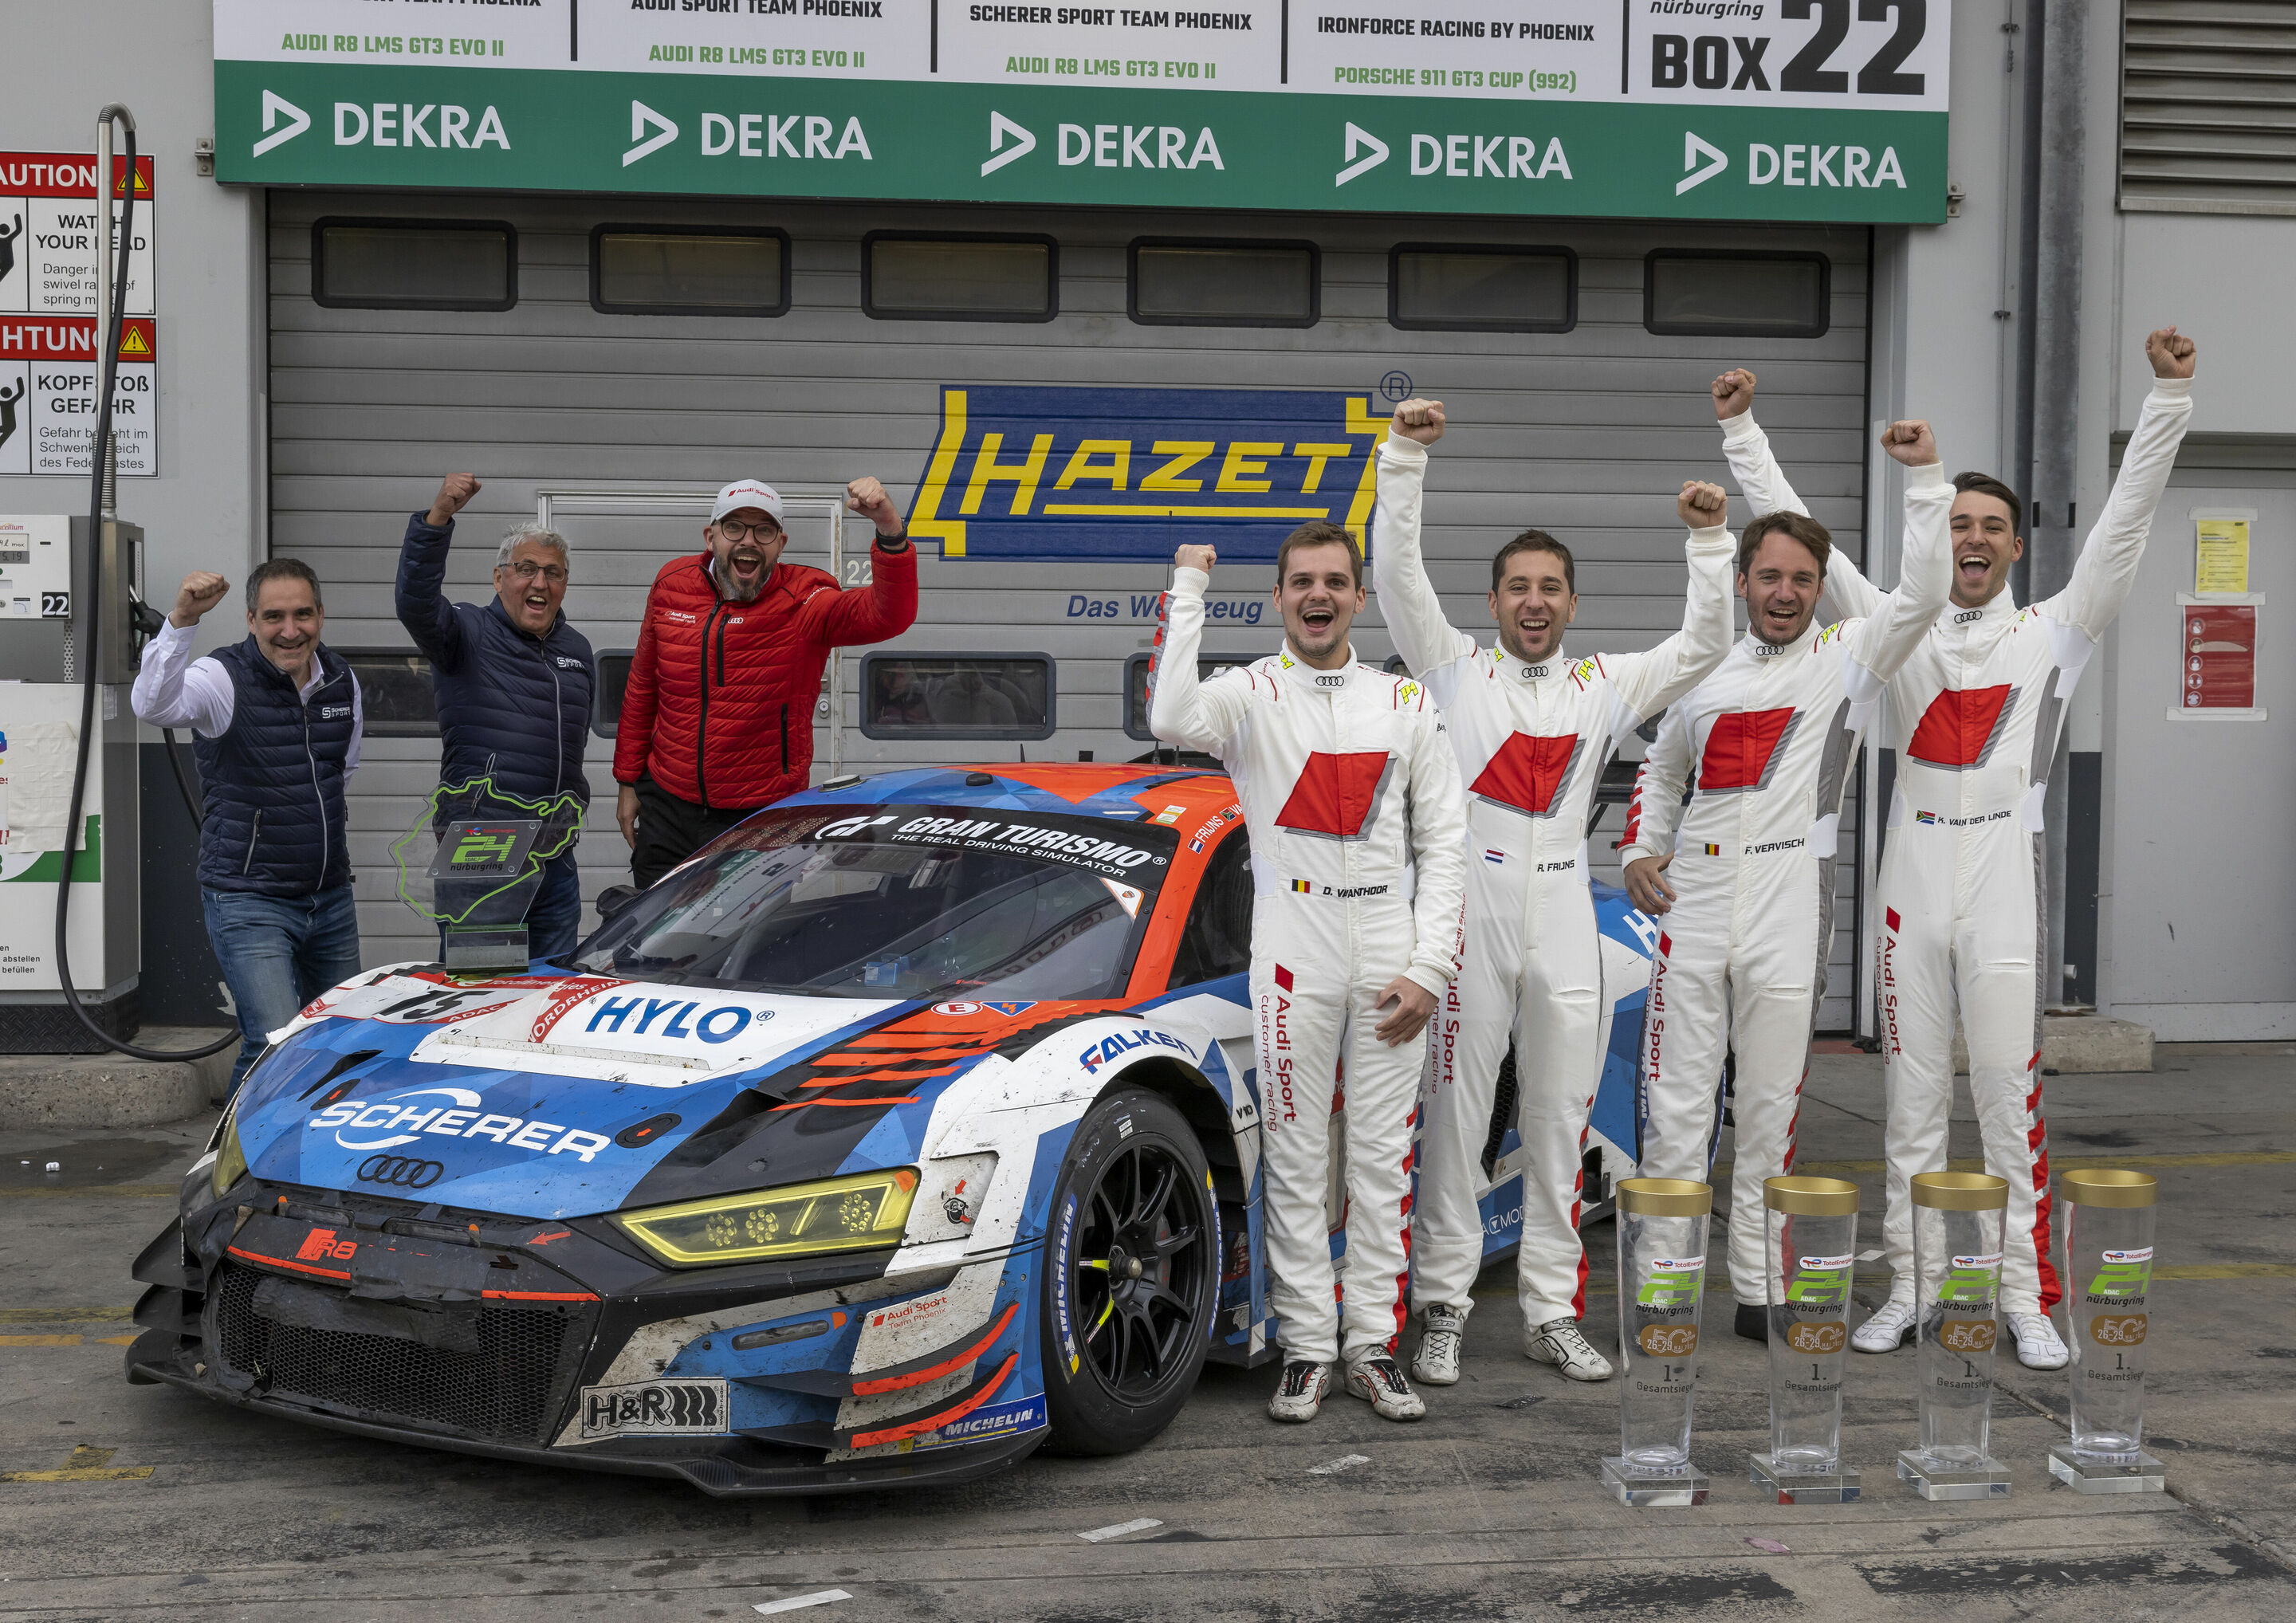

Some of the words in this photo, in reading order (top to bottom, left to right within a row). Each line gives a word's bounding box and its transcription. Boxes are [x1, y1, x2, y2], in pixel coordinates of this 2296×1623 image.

[748, 0, 796, 15] TEAM
[803, 0, 883, 18] PHOENIX
[969, 5, 1052, 24] SCHERER
[1057, 8, 1115, 26] SPORT
[1120, 10, 1169, 28] TEAM
[1174, 12, 1252, 30] PHOENIX
[1318, 16, 1415, 36] IRONFORCE
[1421, 20, 1485, 37] RACING
[1491, 22, 1514, 38] BY
[1519, 23, 1594, 41] PHOENIX
[281, 33, 327, 52] AUDI
[333, 34, 358, 53] R8
[364, 36, 403, 53] LMS
[409, 37, 443, 54] GT3
[450, 38, 486, 56] EVO
[492, 40, 504, 57] II
[649, 45, 693, 62] AUDI
[699, 46, 723, 63] R8
[729, 47, 766, 65] LMS
[773, 49, 806, 66] GT3
[812, 50, 847, 67] EVO
[853, 51, 865, 68] II
[1652, 33, 1771, 91] BOX
[1780, 0, 1926, 96] 22
[1005, 56, 1048, 73] AUDI
[1055, 57, 1078, 74] R8
[1083, 58, 1120, 76] LMS
[1126, 60, 1158, 77] GT3
[1165, 61, 1199, 78] EVO
[1205, 62, 1216, 79] II
[1335, 66, 1415, 85] PORSCHE
[1421, 69, 1446, 86] 911
[1452, 70, 1484, 87] GT3
[1489, 72, 1523, 88] CUP
[1529, 69, 1576, 93] (992)
[334, 101, 511, 150] DEKRA
[701, 112, 873, 159] DEKRA
[1058, 124, 1225, 170] DEKRA
[1410, 134, 1573, 180] DEKRA
[1749, 143, 1907, 188] DEKRA
[58, 214, 124, 230] WATH
[36, 235, 88, 250] YOUR
[43, 263, 88, 277] Danger
[43, 279, 80, 289] swivel
[43, 294, 81, 307] spring
[2, 325, 97, 351] HTUN
[50, 399, 136, 414] GEFHR
[40, 427, 81, 438] Gefahr
[134, 429, 148, 438] im
[40, 458, 61, 467] des
[958, 433, 1352, 516] HAZET
[755, 489, 774, 501] Sport
[847, 560, 874, 584] 22
[42, 595, 69, 615] 22
[1067, 595, 1119, 618] Das
[1194, 815, 1224, 843] FRIJNS
[1970, 815, 1985, 825] DER
[1988, 810, 2011, 821] LINDE
[898, 816, 990, 839] GRAN
[996, 824, 1153, 867] TURISMO
[1755, 838, 1804, 854] VERVISCH
[890, 834, 919, 843] THE
[921, 835, 961, 846] REAL
[963, 839, 1028, 855] DRIVING
[1031, 848, 1126, 877] SIMULATOR
[1323, 886, 1332, 895] D.
[1885, 935, 1896, 988] Audi
[1654, 959, 1668, 1012] Audi
[448, 1004, 501, 1022] ADAC
[1276, 995, 1291, 1051] Audi
[1885, 994, 1901, 1056] Sport
[1079, 1029, 1198, 1075] FALKEN
[1442, 1020, 1460, 1085] Sport
[1649, 1018, 1665, 1083] Sport
[1261, 995, 1271, 1077] customer
[1267, 1081, 1277, 1132] racing
[1277, 1058, 1296, 1122] Sport
[309, 1101, 611, 1163] SCHERER
[887, 1307, 914, 1321] Audi
[916, 1296, 948, 1315] Sport
[1635, 1303, 1694, 1317] nürburgring
[1784, 1303, 1842, 1315] nürburgring
[1935, 1300, 1994, 1313] nürburgring
[2086, 1295, 2145, 1307] nürburgring
[889, 1318, 913, 1330] Team
[914, 1307, 946, 1321] Phoenix
[1647, 1338, 1673, 1350] 26-29
[1795, 1336, 1820, 1348] 26-29
[1948, 1334, 1973, 1346] 26-29
[2097, 1329, 2124, 1340] 26-29
[588, 1387, 672, 1431] H&R
[945, 1408, 1034, 1436] MICHELIN
